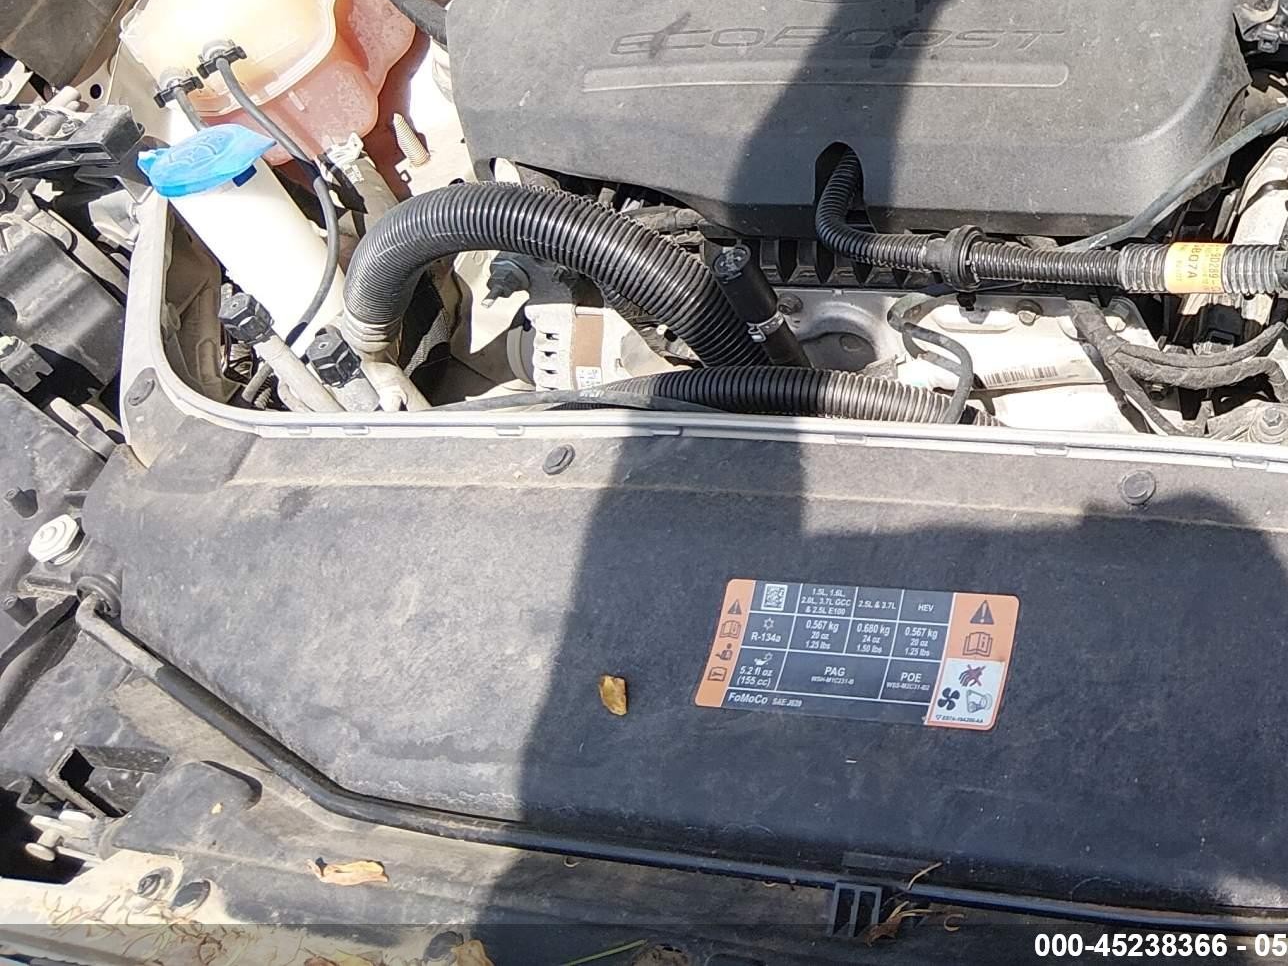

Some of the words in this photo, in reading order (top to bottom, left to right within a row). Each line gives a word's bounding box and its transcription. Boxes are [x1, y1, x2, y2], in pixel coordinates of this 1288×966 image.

[917, 604, 934, 612] HEV
[805, 619, 827, 630] 0.567
[828, 621, 840, 633] kg
[856, 622, 879, 634] 0.680
[880, 624, 890, 636] kg
[750, 631, 781, 642] R-134a
[905, 626, 927, 636] 0.567
[927, 629, 938, 639] kg
[862, 635, 871, 643] 24
[910, 638, 919, 646] 20
[805, 640, 819, 649] 1.25
[820, 641, 831, 650] lbs
[857, 644, 871, 652] 1.50
[872, 645, 882, 654] lbs
[905, 647, 919, 656] 1.25
[919, 648, 930, 657] lbs
[739, 665, 754, 675] 5.2
[754, 667, 761, 676] fl
[761, 669, 774, 677] oz
[823, 666, 846, 677] PAG
[736, 675, 756, 686] (155
[756, 677, 771, 688] cc)
[900, 671, 922, 683] POE
[727, 691, 768, 704] FoMoCo
[771, 697, 787, 706] SAE
